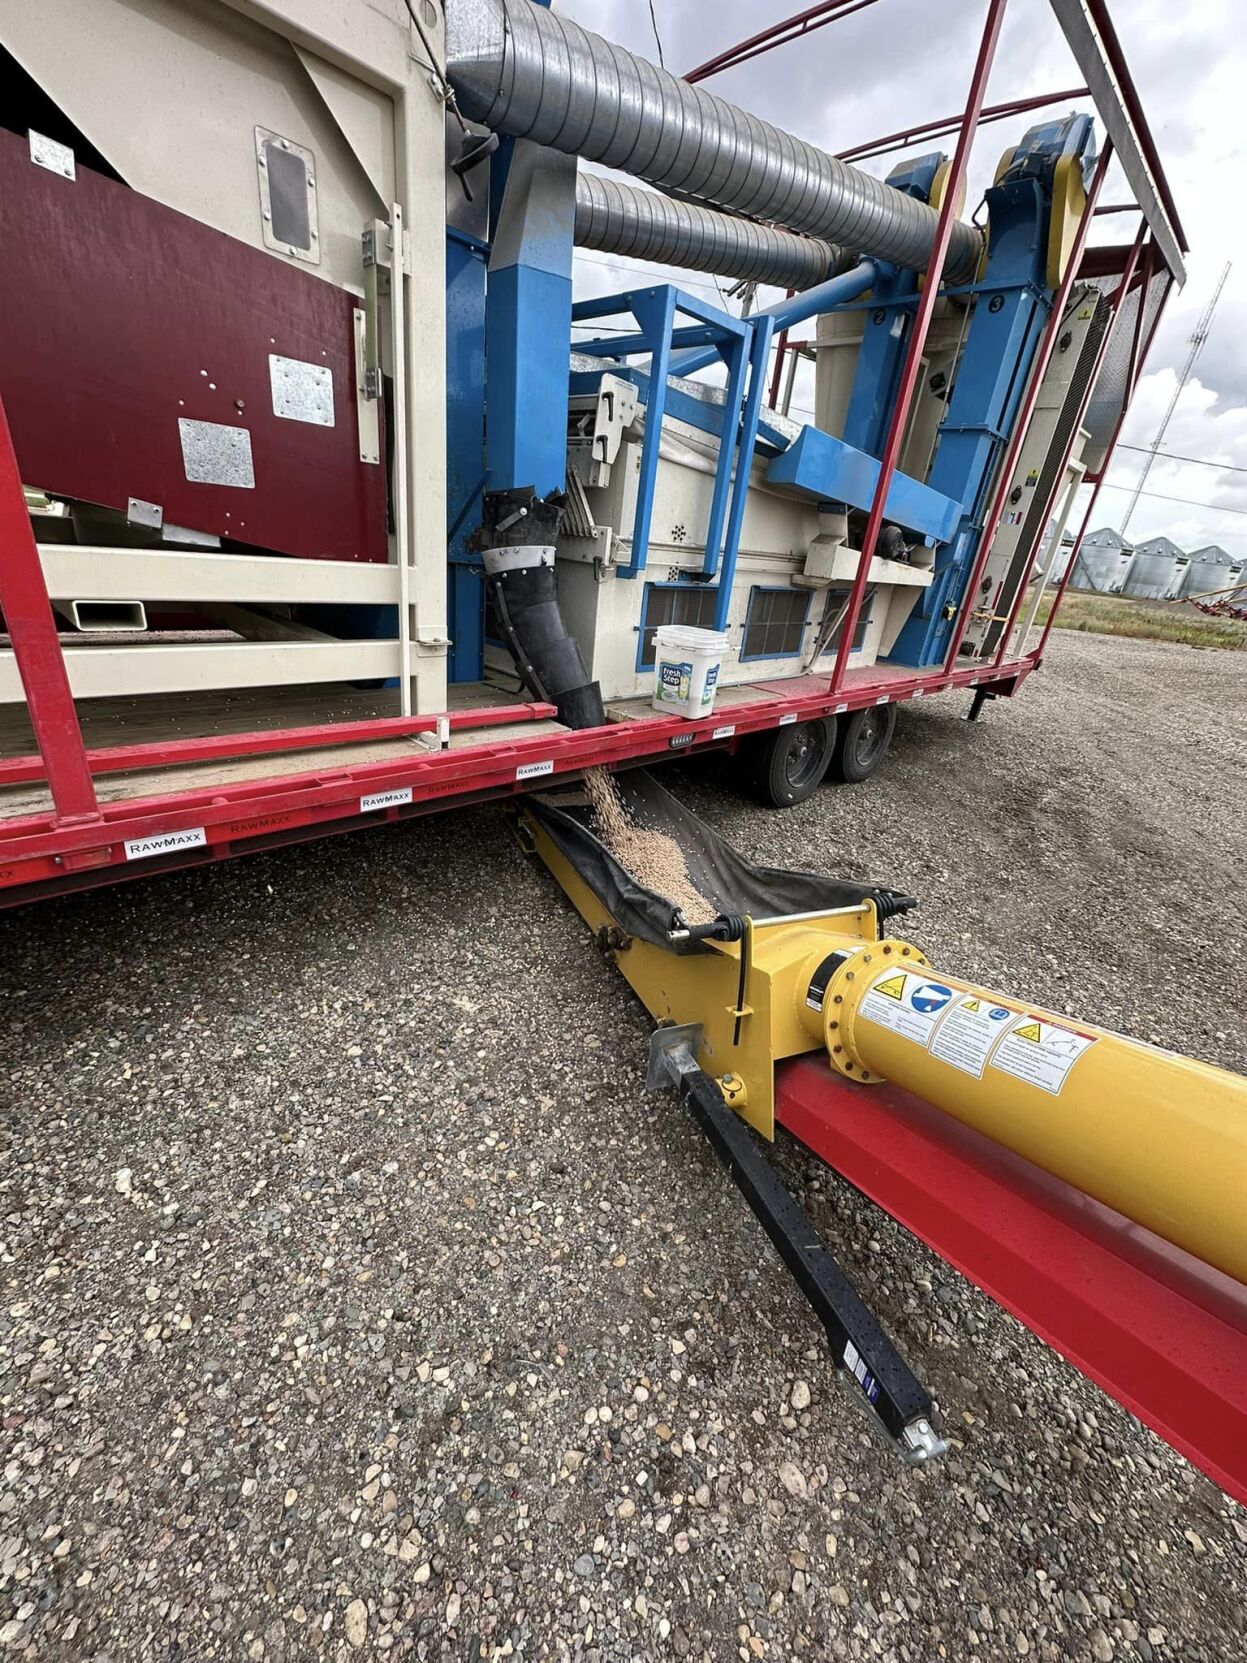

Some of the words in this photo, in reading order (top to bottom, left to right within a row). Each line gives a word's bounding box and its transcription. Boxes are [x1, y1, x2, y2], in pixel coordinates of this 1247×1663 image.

[992, 297, 1001, 311] 3
[876, 311, 884, 323] 2
[663, 667, 681, 677] Fresh
[663, 675, 680, 685] Step
